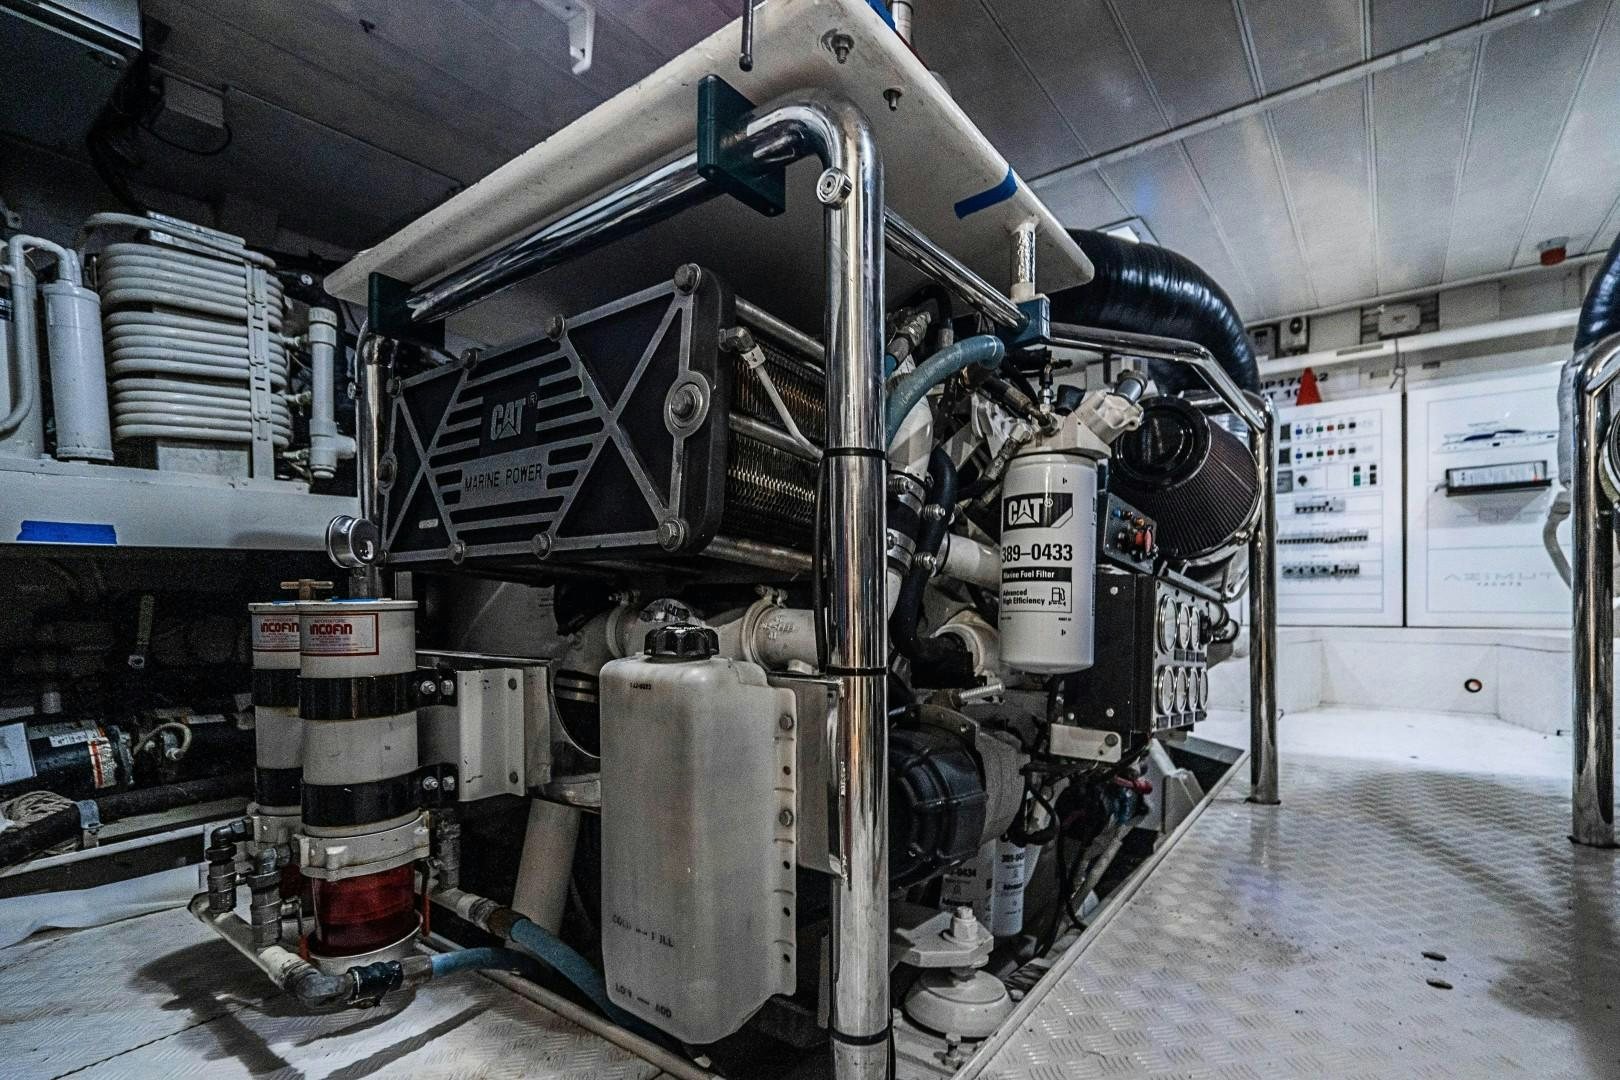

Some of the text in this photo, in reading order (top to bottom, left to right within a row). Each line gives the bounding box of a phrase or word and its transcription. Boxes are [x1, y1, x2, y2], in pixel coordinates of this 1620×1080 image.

[491, 398, 526, 440] CAT
[465, 463, 543, 490] MARINE POWER
[1008, 498, 1044, 526] CAT
[1002, 543, 1073, 564] 389-0433
[1020, 569, 1035, 579] Fuel
[1035, 569, 1055, 578] Filter
[1013, 596, 1045, 606] Efficiency
